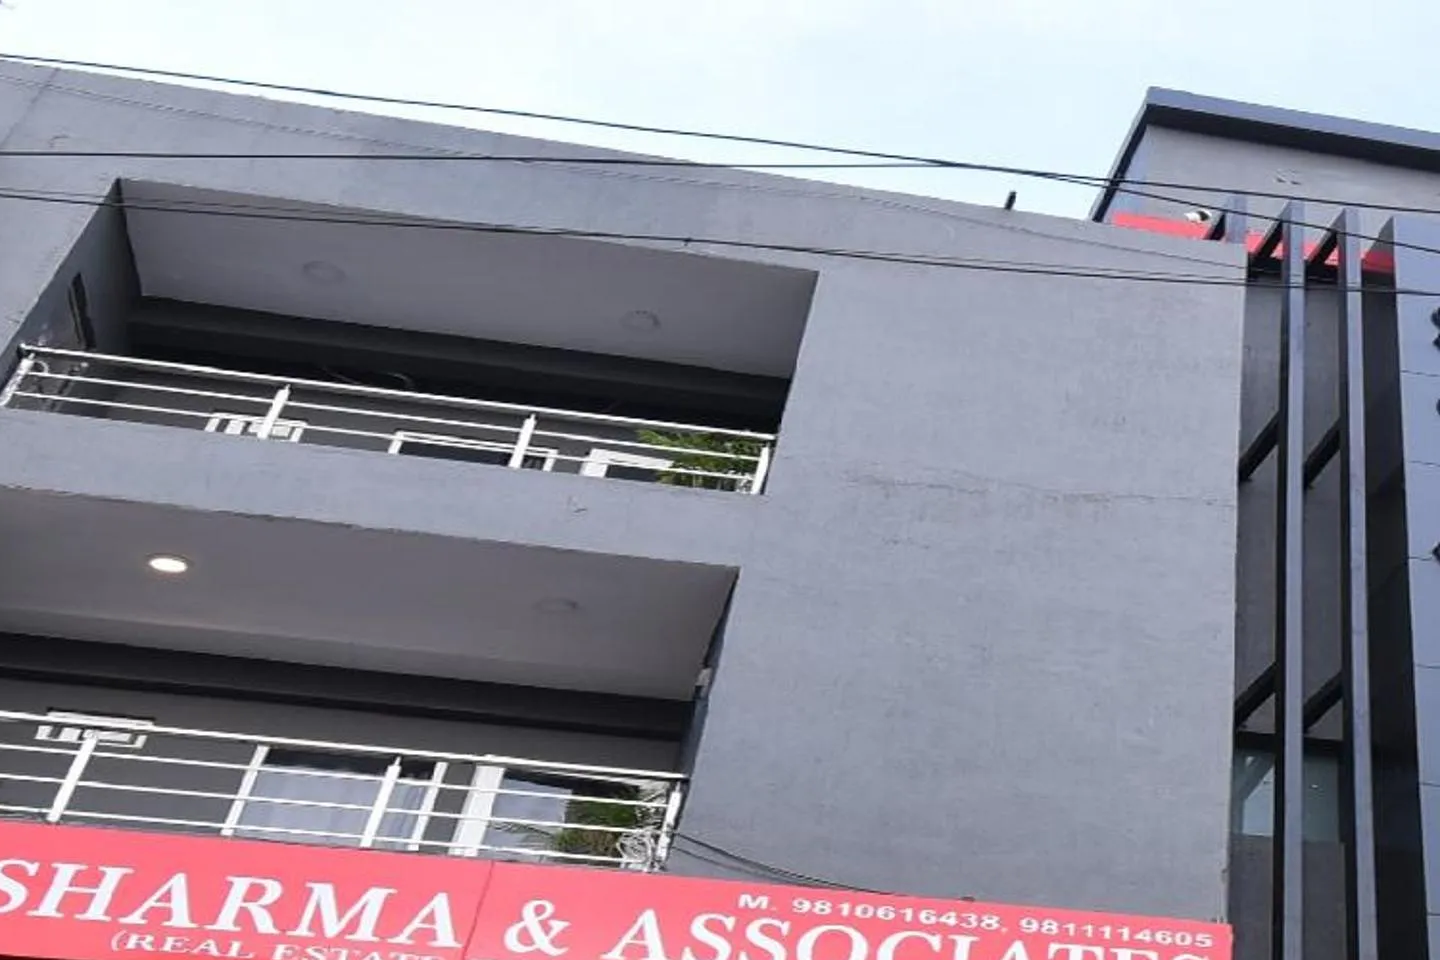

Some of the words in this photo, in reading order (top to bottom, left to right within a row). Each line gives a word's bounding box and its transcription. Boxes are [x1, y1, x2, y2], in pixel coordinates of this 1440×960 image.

[109, 928, 256, 960] (REAL
[503, 898, 572, 957] &
[1019, 914, 1215, 949] 9811114605
